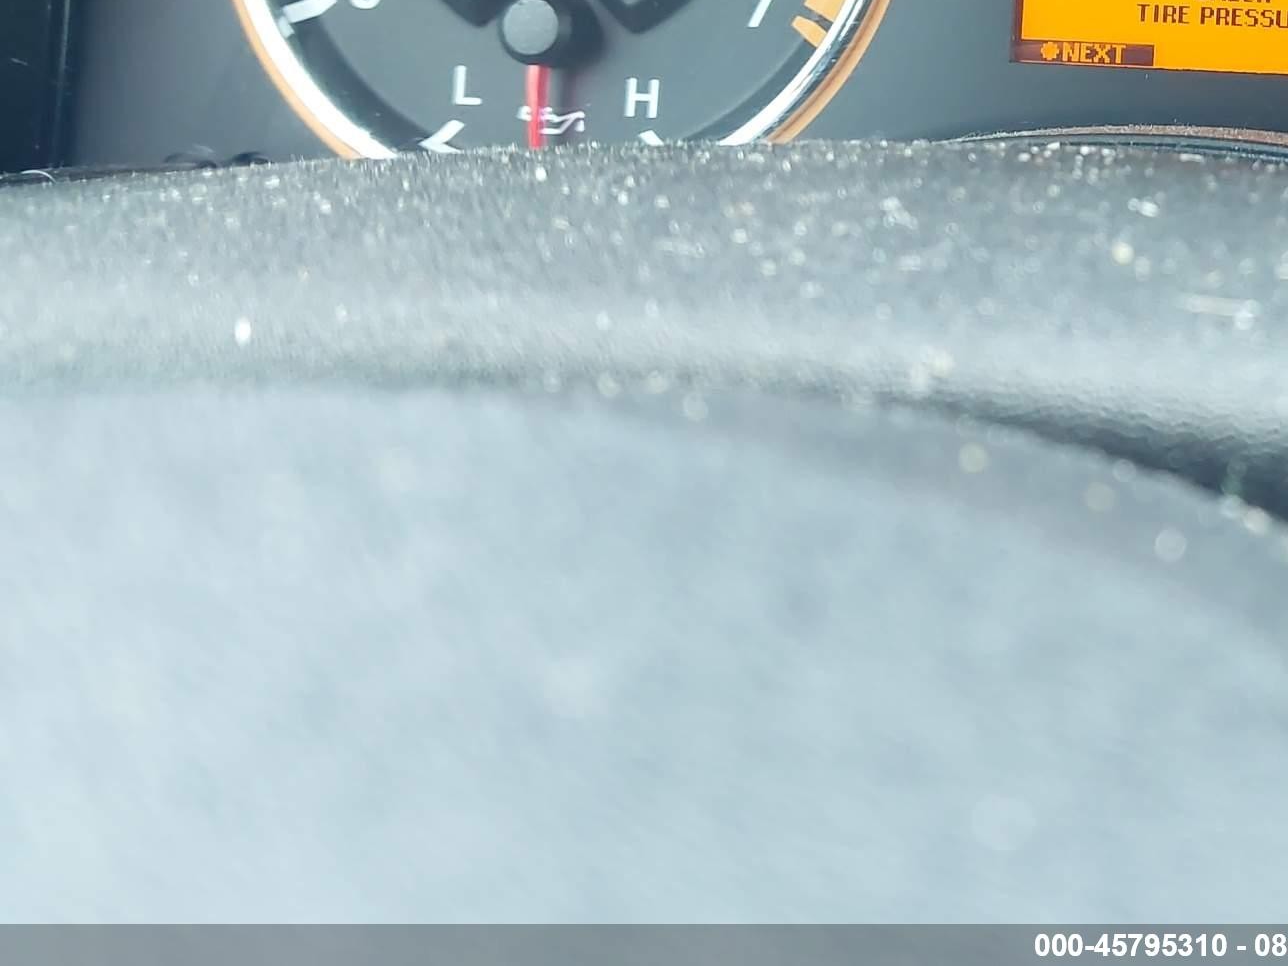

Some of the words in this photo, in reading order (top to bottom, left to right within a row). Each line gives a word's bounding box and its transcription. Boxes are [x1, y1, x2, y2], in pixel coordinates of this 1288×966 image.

[1137, 3, 1190, 26] TIRE
[1060, 42, 1126, 64] NEXT
[452, 65, 483, 107] L
[624, 76, 661, 119] H
